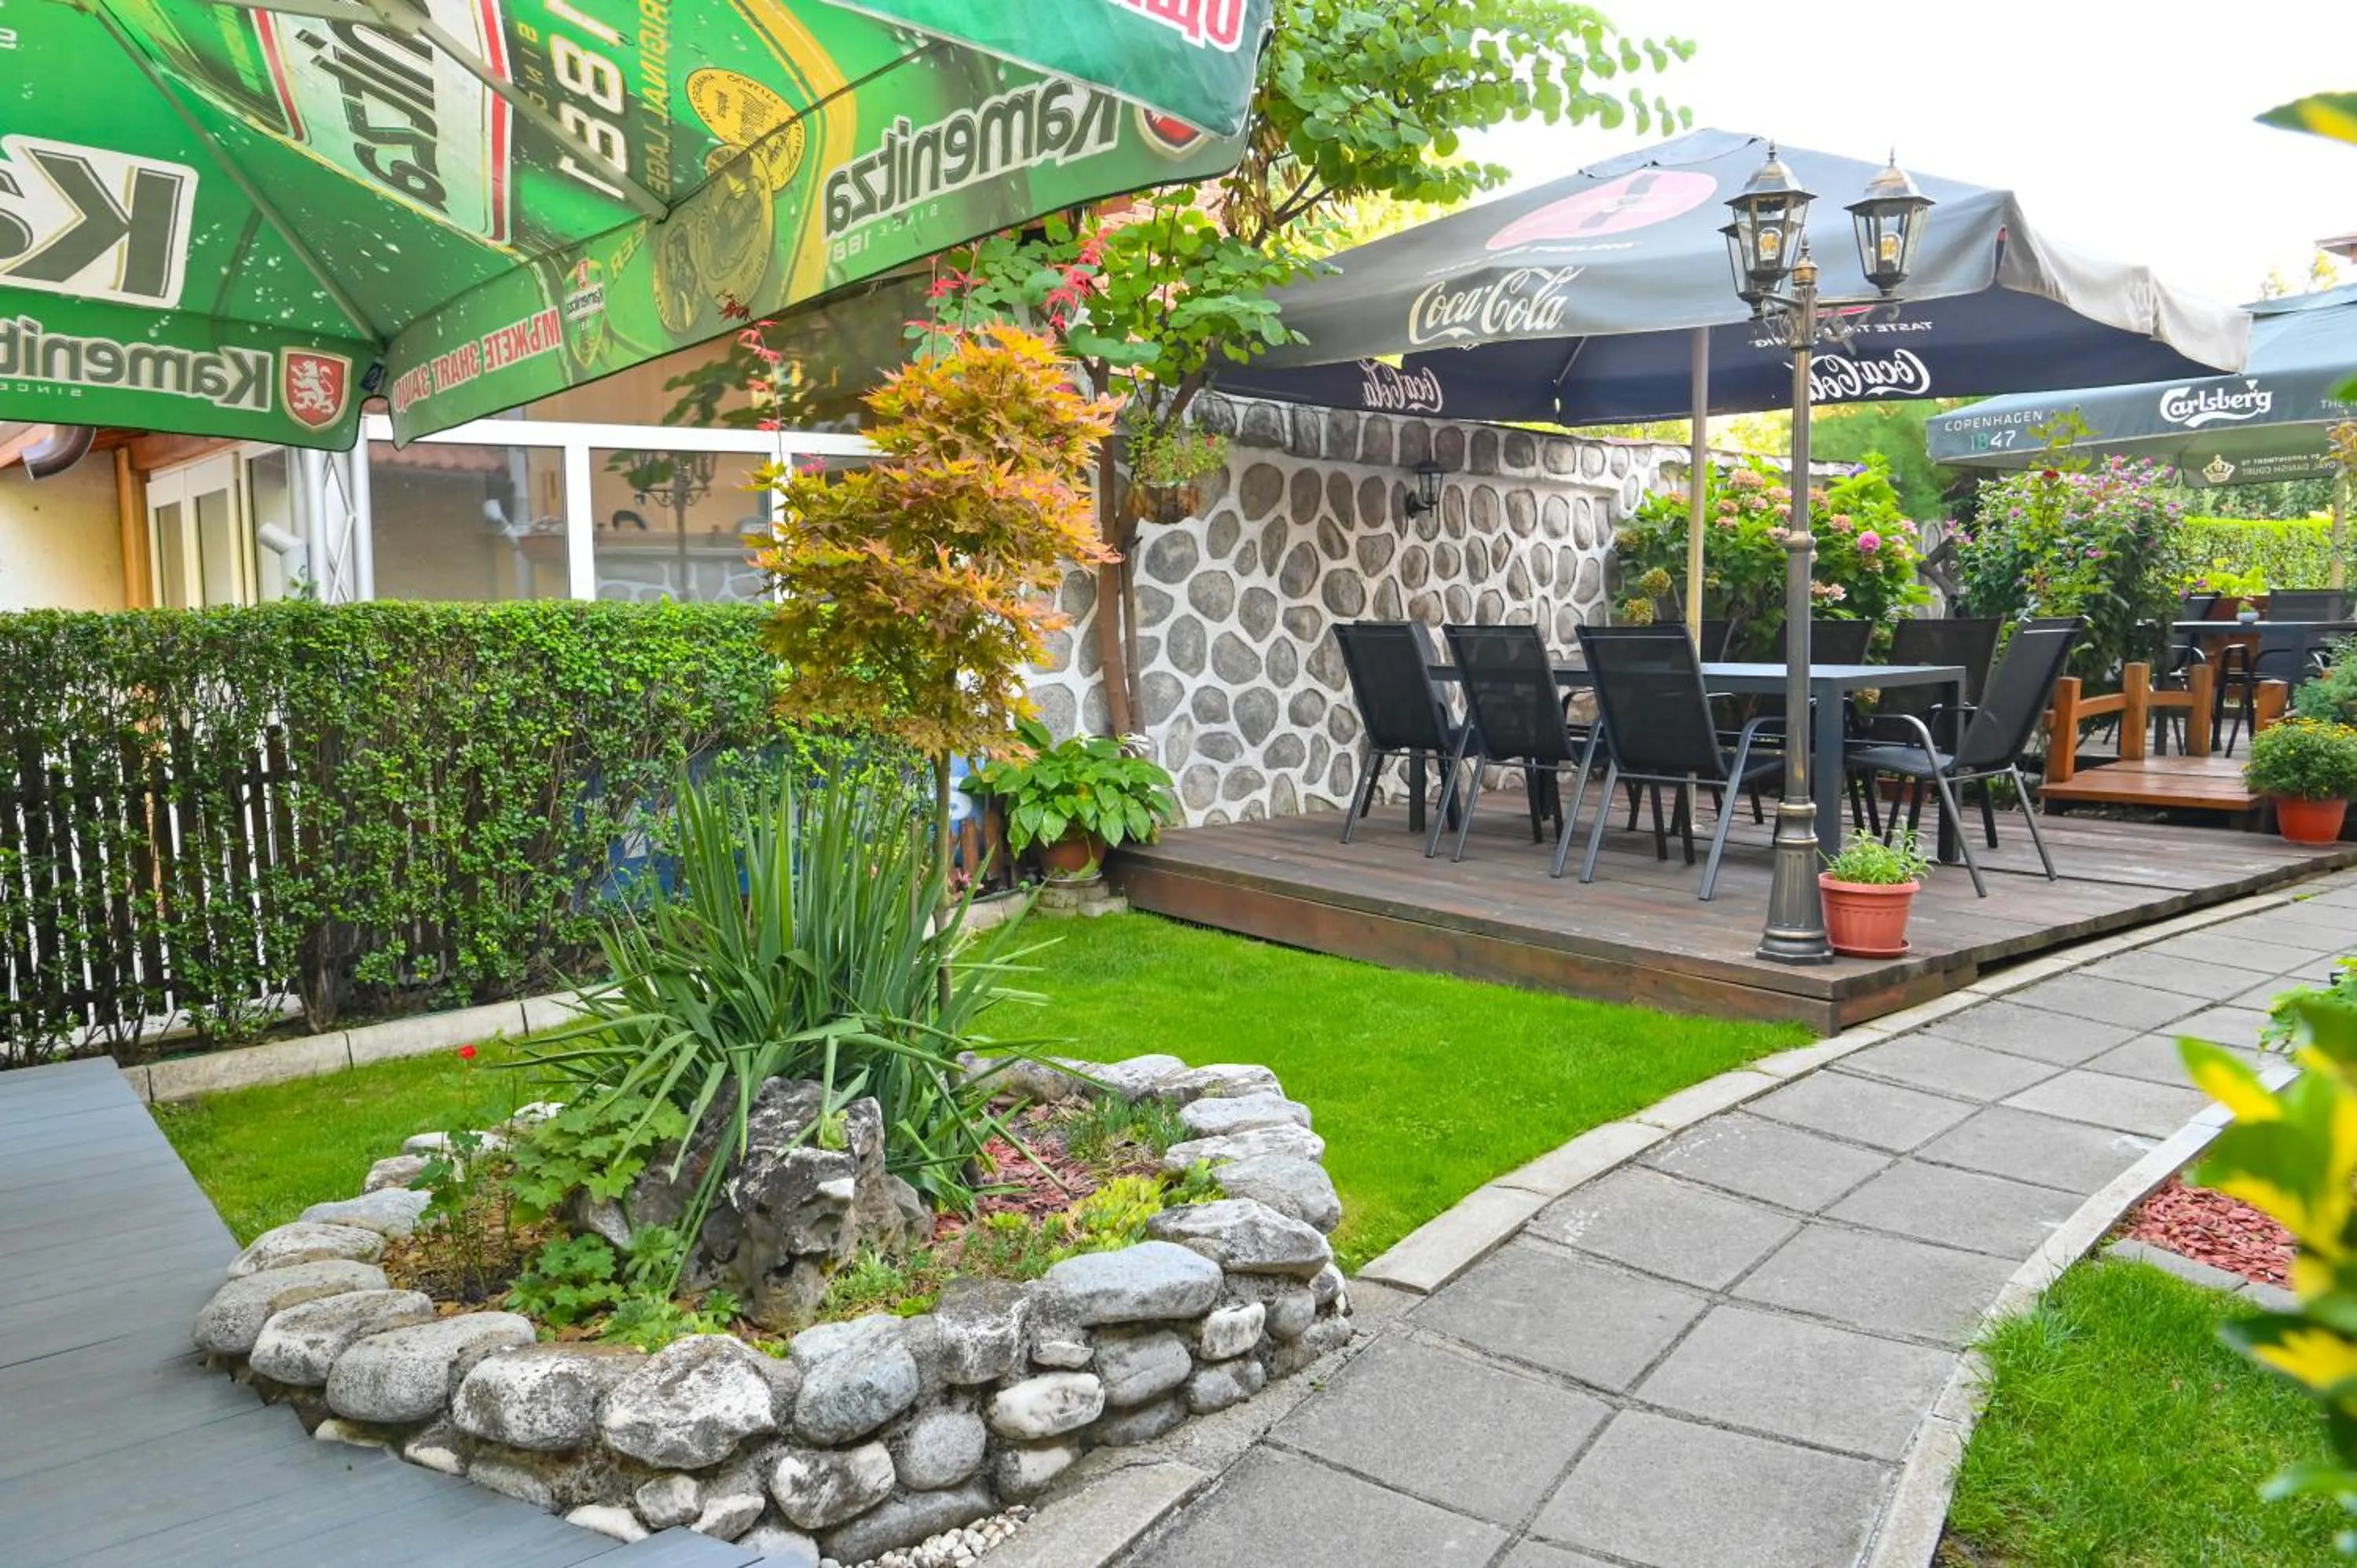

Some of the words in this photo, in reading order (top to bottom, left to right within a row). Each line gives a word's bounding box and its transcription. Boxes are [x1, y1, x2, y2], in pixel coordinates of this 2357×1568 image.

[1409, 265, 1585, 345] Coca-Cola
[1945, 409, 2043, 433] COPENHAGEN
[2160, 386, 2273, 428] Carlsberg
[1970, 429, 2017, 452] 1847
